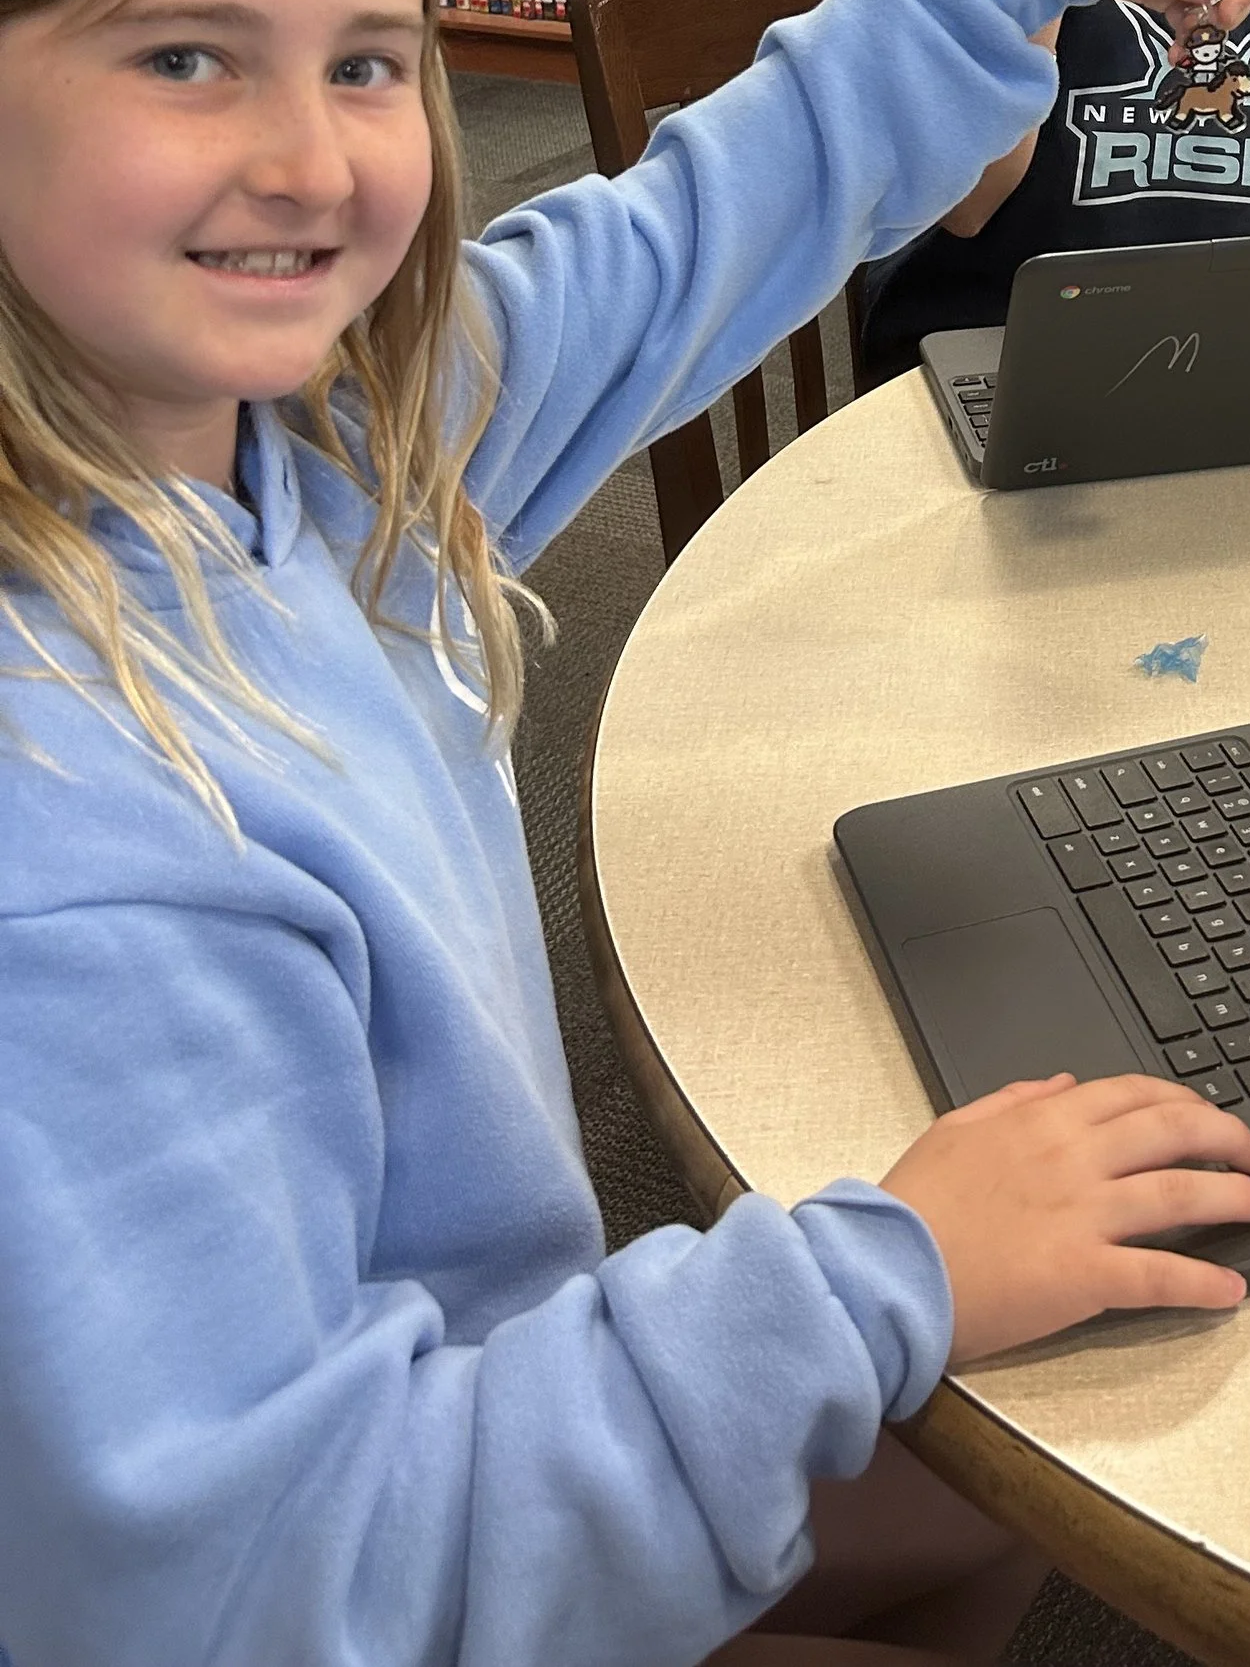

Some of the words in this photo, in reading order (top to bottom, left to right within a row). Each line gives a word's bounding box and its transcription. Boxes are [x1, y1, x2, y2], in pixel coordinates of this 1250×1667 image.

[1083, 104, 1172, 125] NEW
[1084, 283, 1131, 296] chrome
[1216, 1004, 1227, 1014] m
